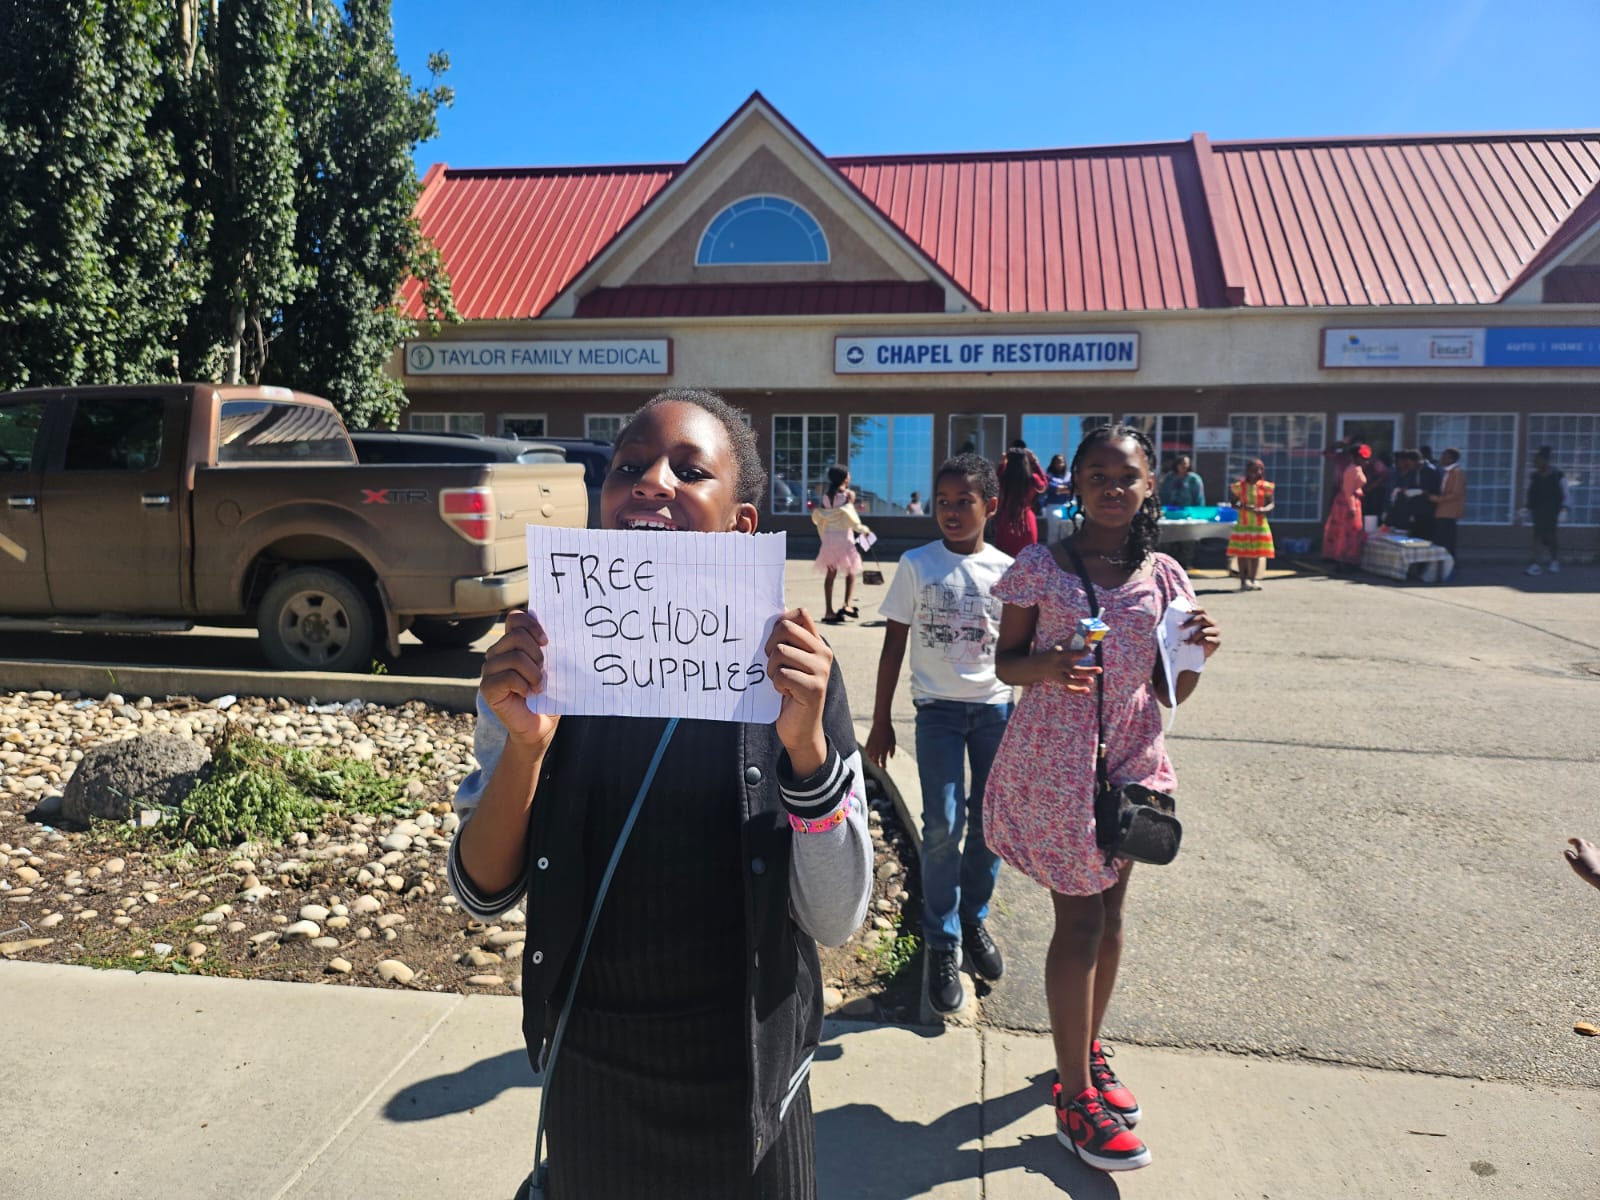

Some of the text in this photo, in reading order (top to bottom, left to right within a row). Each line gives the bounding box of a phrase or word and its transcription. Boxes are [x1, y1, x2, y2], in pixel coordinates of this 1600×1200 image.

[439, 348, 661, 366] TAYLOR FAMILY MEDICAL
[877, 341, 1134, 365] CHAPEL OF RESTORATION
[1551, 342, 1584, 352] HOME
[360, 488, 432, 504] XTR
[550, 552, 656, 599] FREE
[584, 601, 744, 645] SCHOOL
[593, 653, 765, 692] SUPPLIES
